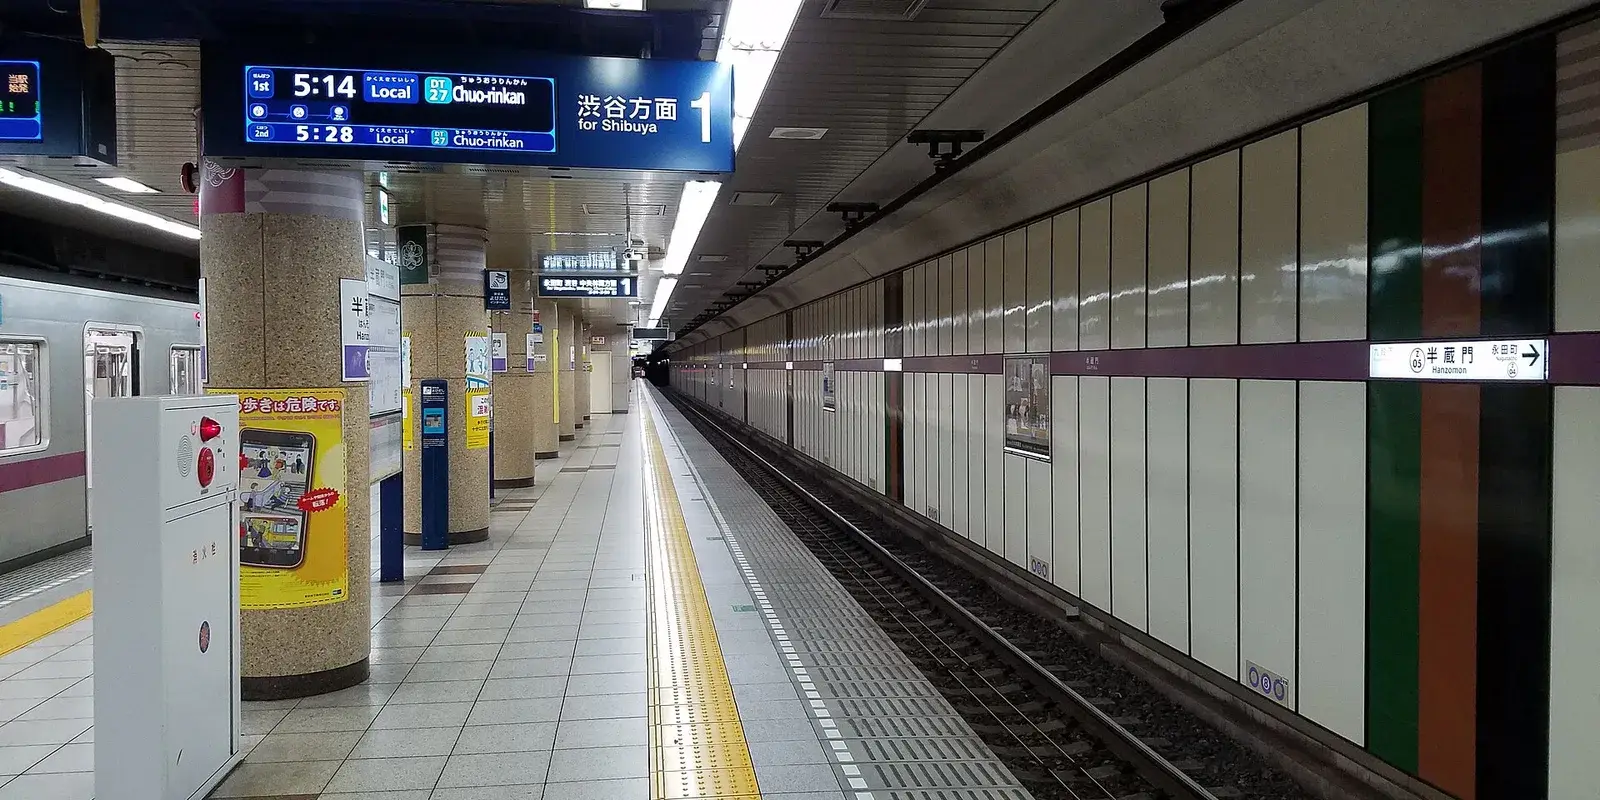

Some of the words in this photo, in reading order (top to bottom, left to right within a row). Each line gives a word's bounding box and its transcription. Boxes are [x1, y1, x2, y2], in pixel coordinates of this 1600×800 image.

[253, 80, 270, 92] 1st
[294, 73, 356, 98] 5:14
[430, 80, 446, 89] DT
[371, 84, 411, 99] Local
[429, 89, 448, 101] 27
[452, 85, 525, 105] Chuo-rinkan
[577, 94, 678, 121] 渋谷方面
[690, 91, 711, 143] 1
[578, 118, 598, 130] for
[601, 120, 658, 135] Shibuya
[255, 130, 269, 138] 2nd
[296, 125, 354, 143] 5:28
[376, 133, 409, 145] Local
[433, 137, 446, 145] 27
[453, 135, 524, 148] Chuo-rinkan
[620, 278, 631, 296] 1
[1427, 346, 1474, 364] 半蔵門
[1492, 344, 1518, 355] 永田町
[1412, 359, 1422, 369] 05
[1432, 366, 1468, 375] Hanzomon
